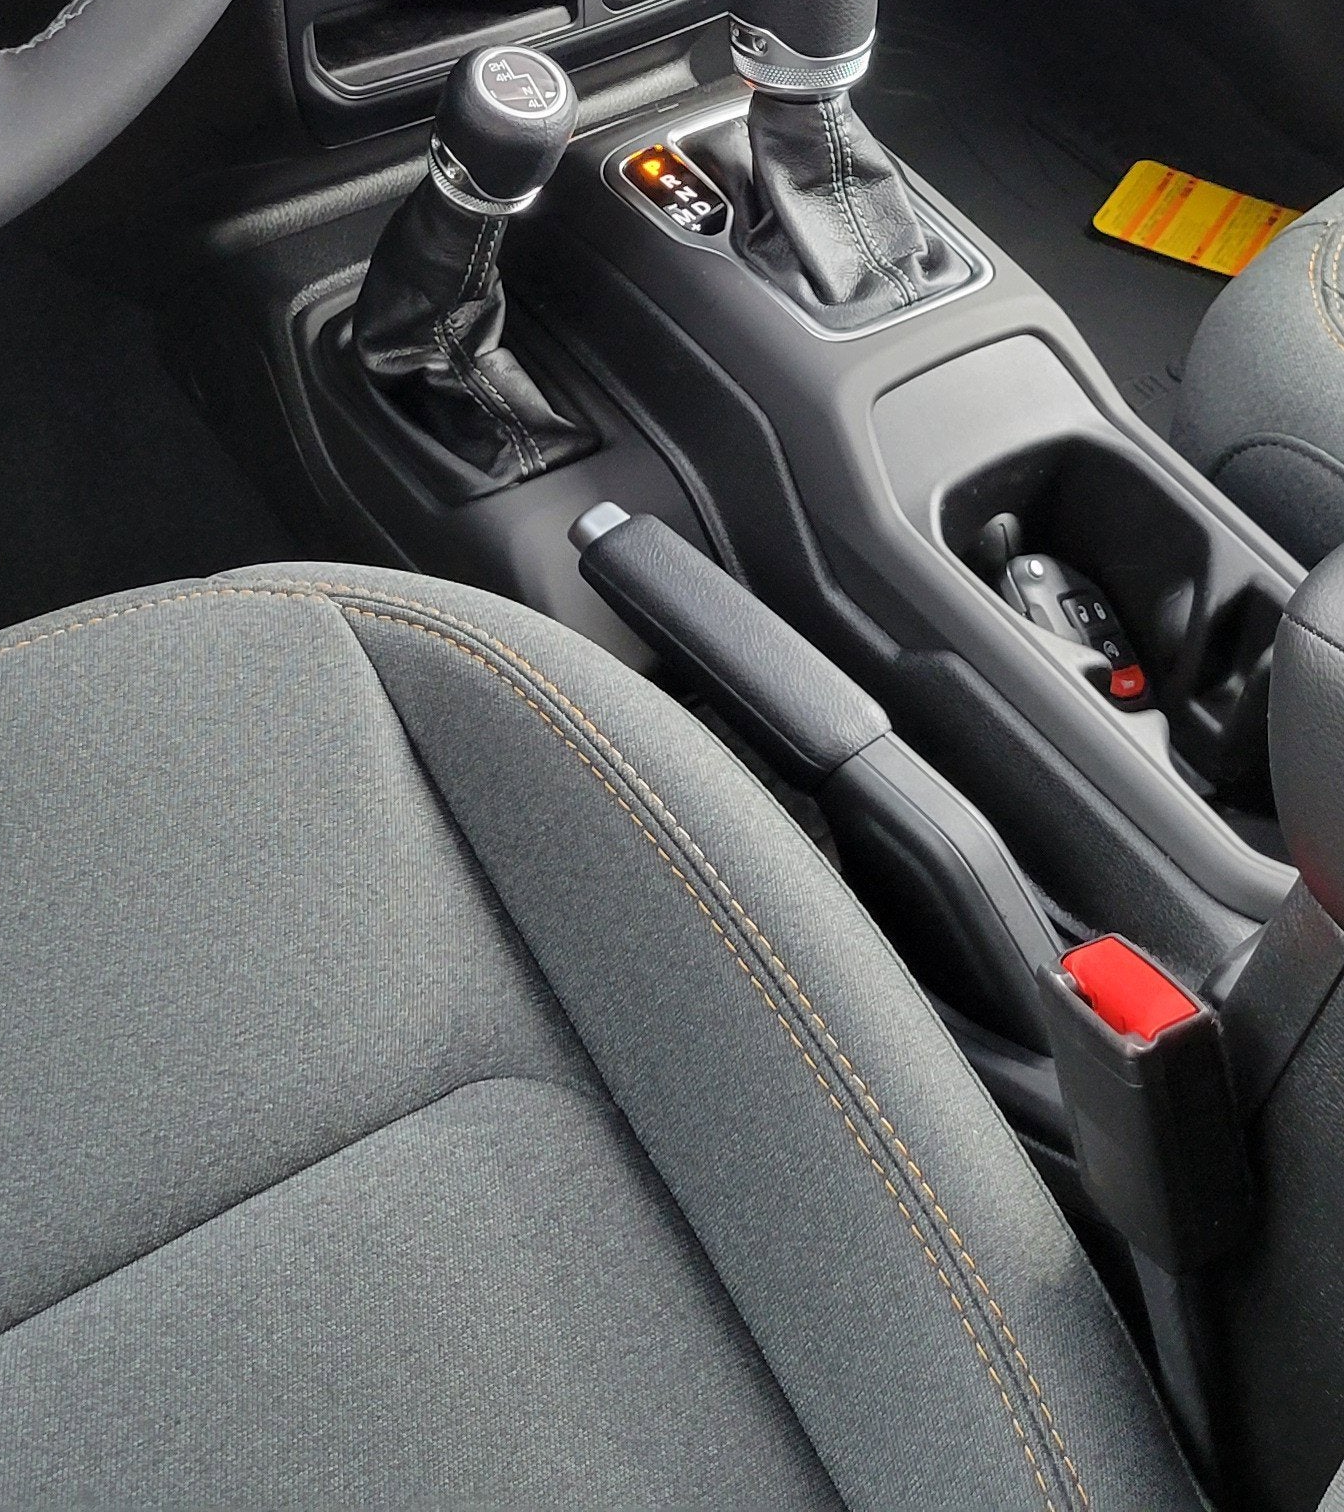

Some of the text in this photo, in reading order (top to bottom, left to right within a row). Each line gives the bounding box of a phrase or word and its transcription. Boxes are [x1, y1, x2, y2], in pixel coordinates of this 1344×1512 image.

[488, 60, 506, 72] 2H
[496, 72, 513, 82] 4H
[521, 86, 534, 96] N
[528, 98, 543, 108] 4L
[643, 159, 661, 177] P
[659, 173, 682, 189] R
[674, 185, 698, 202] N
[690, 200, 712, 216] D
[671, 207, 697, 227] M
